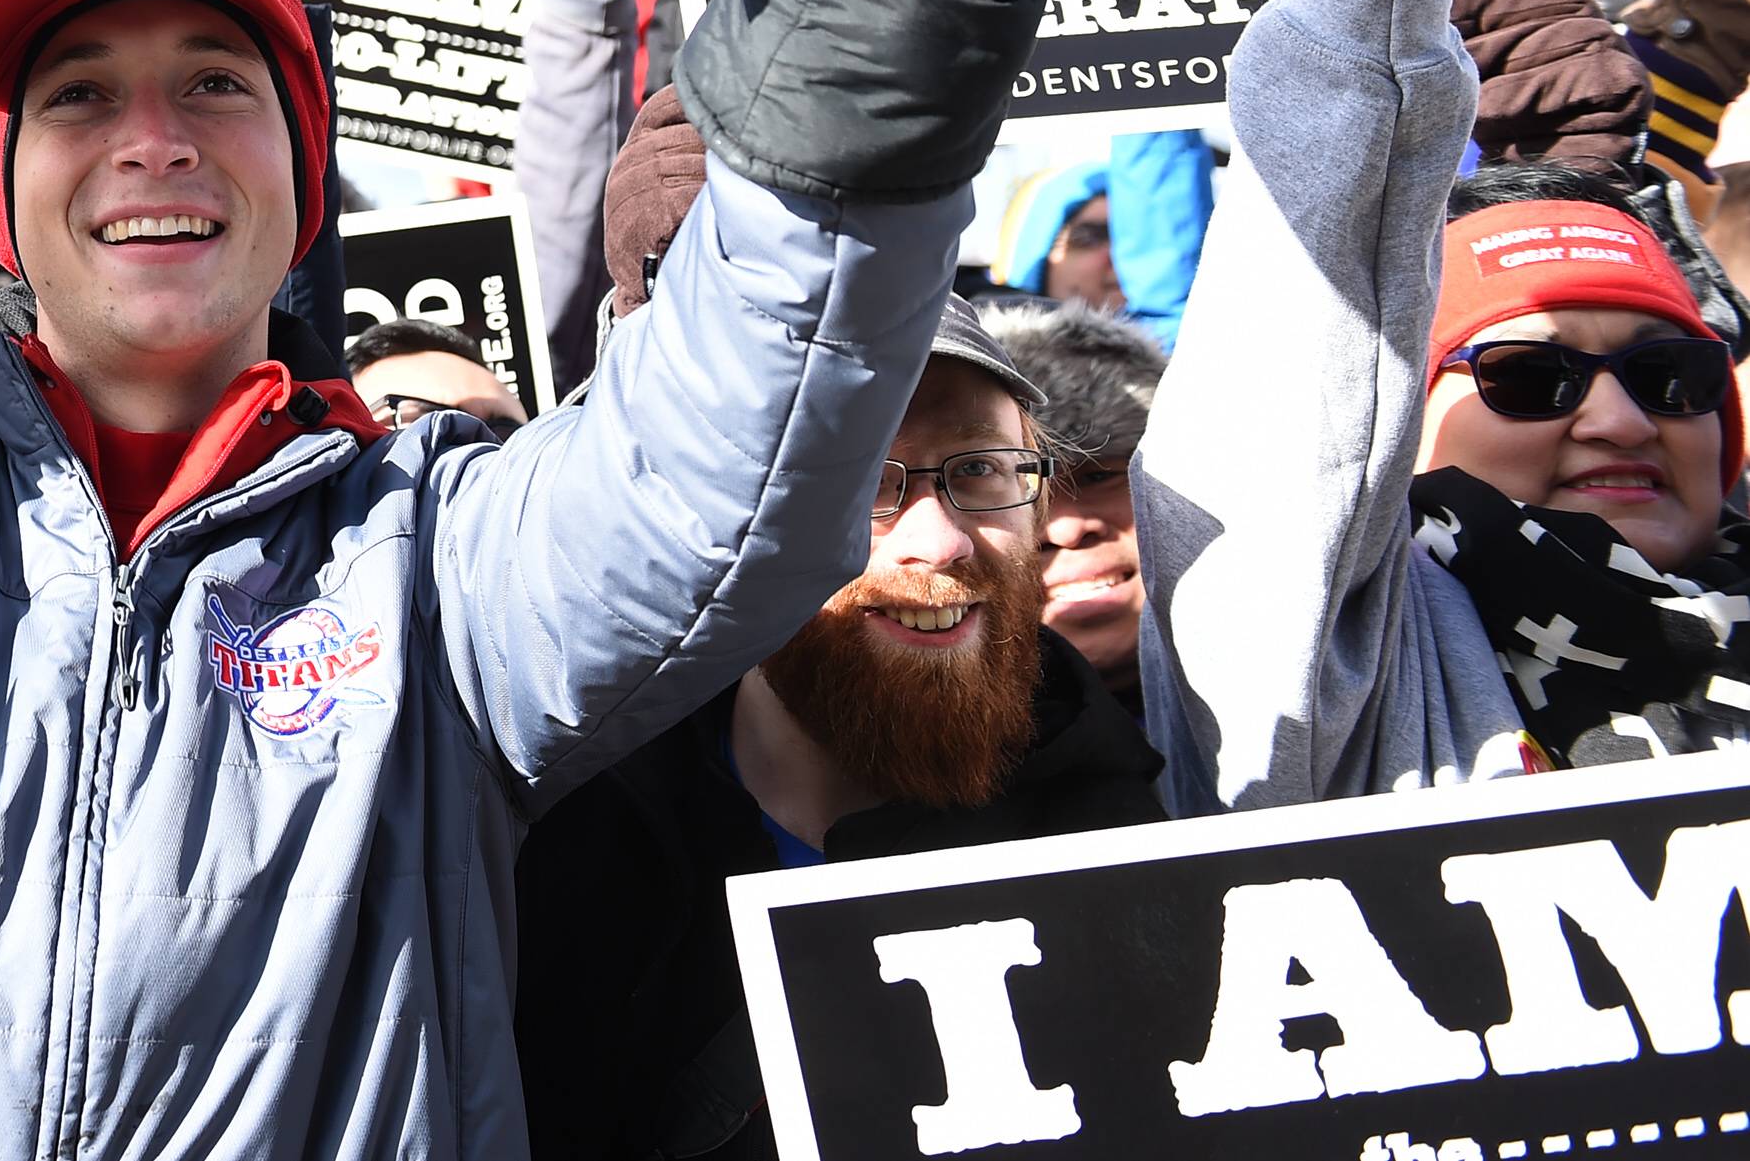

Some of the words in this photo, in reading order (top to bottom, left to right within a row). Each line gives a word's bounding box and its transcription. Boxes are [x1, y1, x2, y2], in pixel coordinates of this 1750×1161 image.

[212, 626, 381, 690] TITANS
[871, 915, 1083, 1157] I
[1167, 818, 1750, 1118] AM
